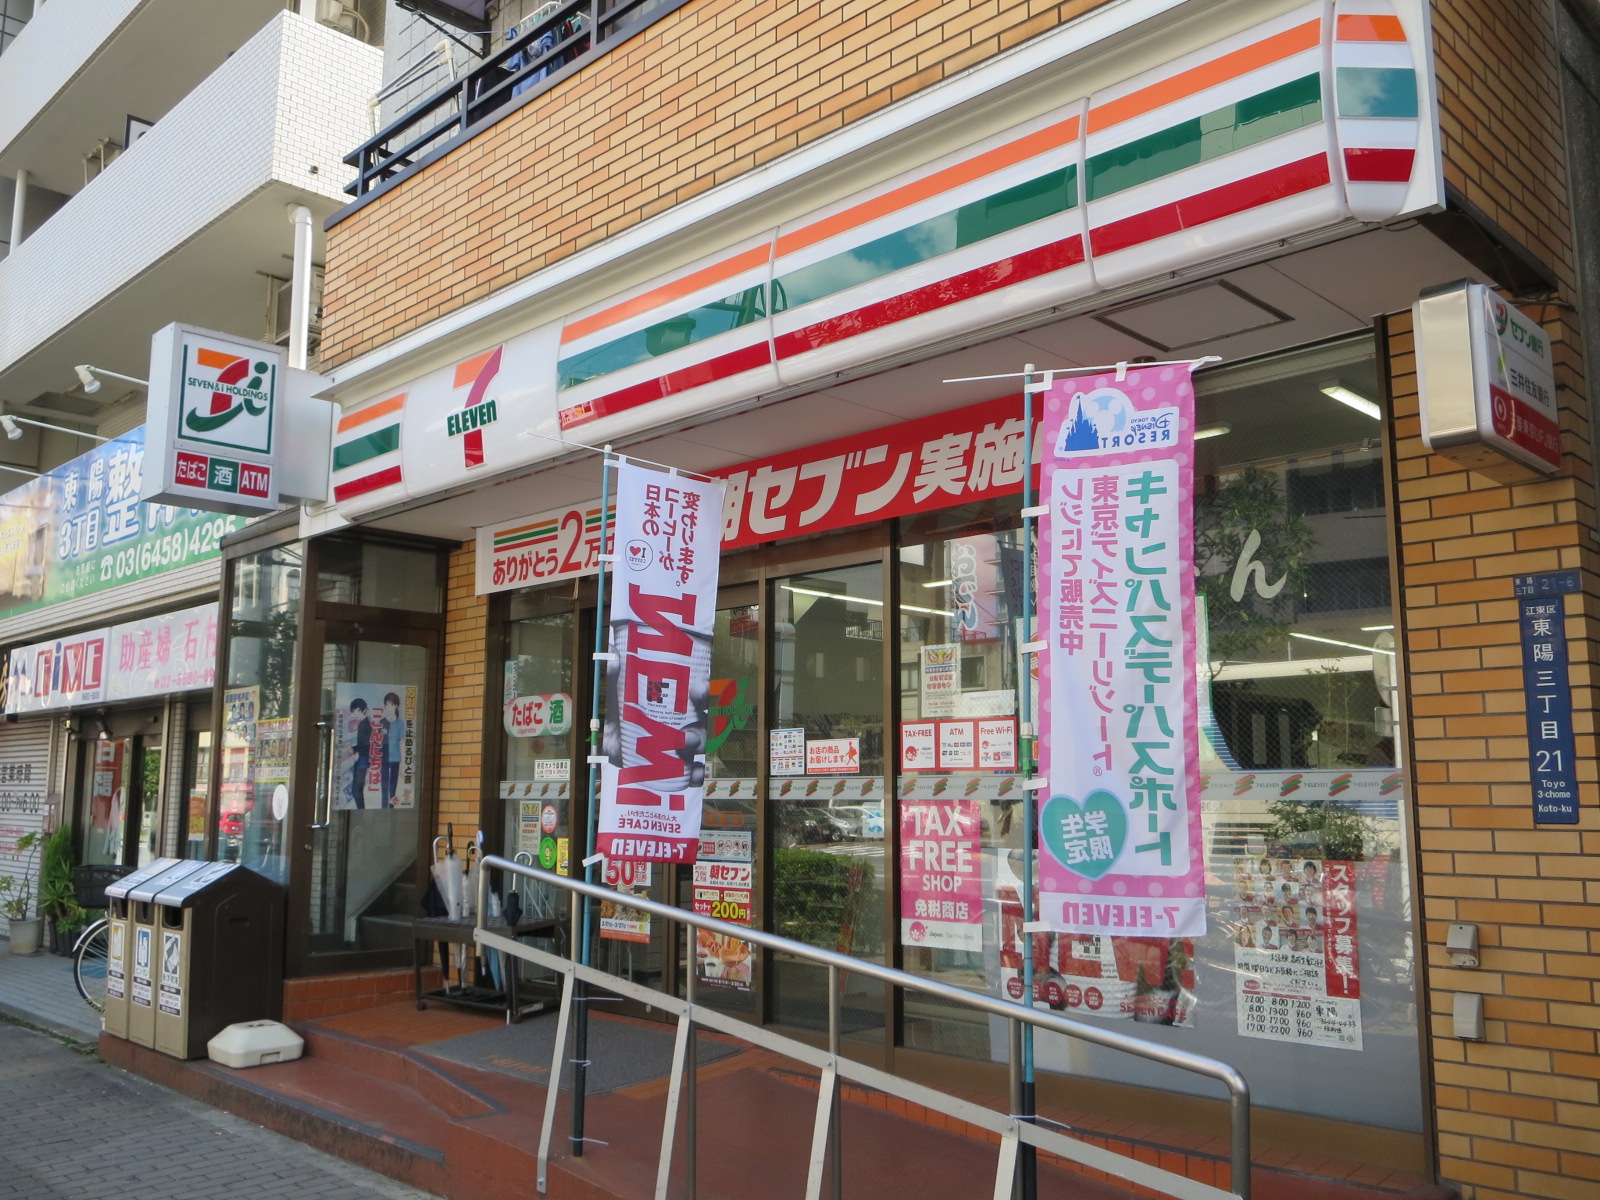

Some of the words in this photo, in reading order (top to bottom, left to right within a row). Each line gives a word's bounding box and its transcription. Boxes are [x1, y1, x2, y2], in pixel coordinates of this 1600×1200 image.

[226, 386, 269, 401] HOLDINGS
[1510, 367, 1550, 408] 三井住友銀行
[177, 459, 206, 481] たばこ
[214, 465, 233, 486] 酒
[710, 417, 1043, 543] セブン実施
[241, 470, 268, 492] ATM
[59, 508, 100, 560] 3丁目
[1516, 586, 1535, 595] 三丁目
[1525, 604, 1556, 615] 江東区
[119, 626, 172, 672] 助産婦
[1531, 618, 1559, 741] 東陽三丁目
[511, 702, 544, 727] たばこ
[549, 699, 564, 724] 酒
[517, 727, 537, 735] cigarette
[949, 728, 964, 736] ATM
[980, 727, 995, 735] Free
[995, 726, 1013, 735] Wi-Fi
[809, 745, 840, 755] お店の商品
[1536, 750, 1563, 772] 21
[1541, 780, 1566, 788] Toyo
[1537, 790, 1571, 799] 3-chome
[1538, 804, 1572, 814] Koto-ku
[909, 805, 963, 837] TAX
[909, 840, 973, 872] FREE
[710, 864, 751, 881] 朝セブン
[922, 874, 963, 893] SHOP
[712, 901, 747, 920] 200円
[915, 898, 969, 920] 免税商店
[1297, 1028, 1313, 1038] 960
